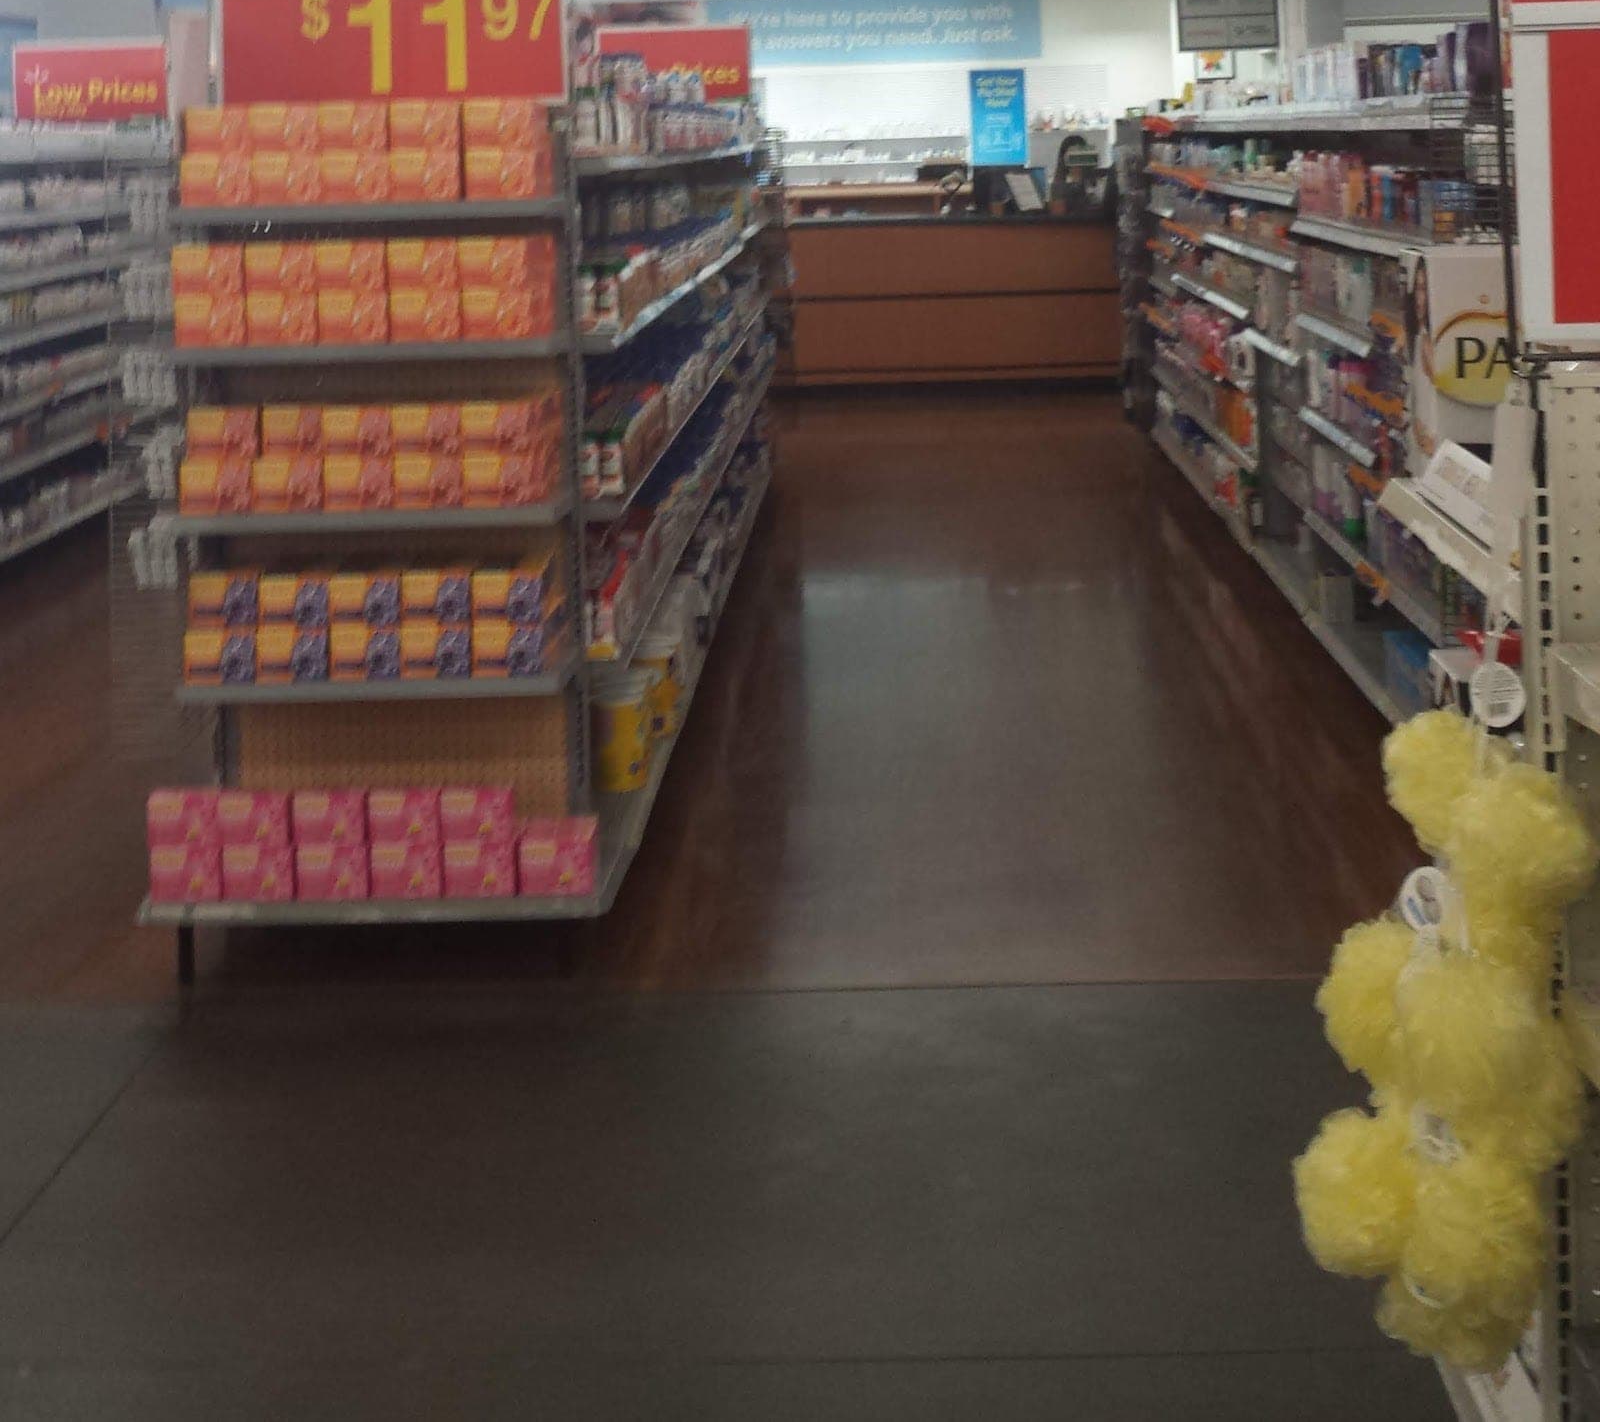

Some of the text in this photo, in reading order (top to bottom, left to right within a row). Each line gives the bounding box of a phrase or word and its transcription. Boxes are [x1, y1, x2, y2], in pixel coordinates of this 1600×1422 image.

[854, 3, 928, 28] provide
[970, 0, 1013, 21] with
[87, 76, 159, 105] Prices
